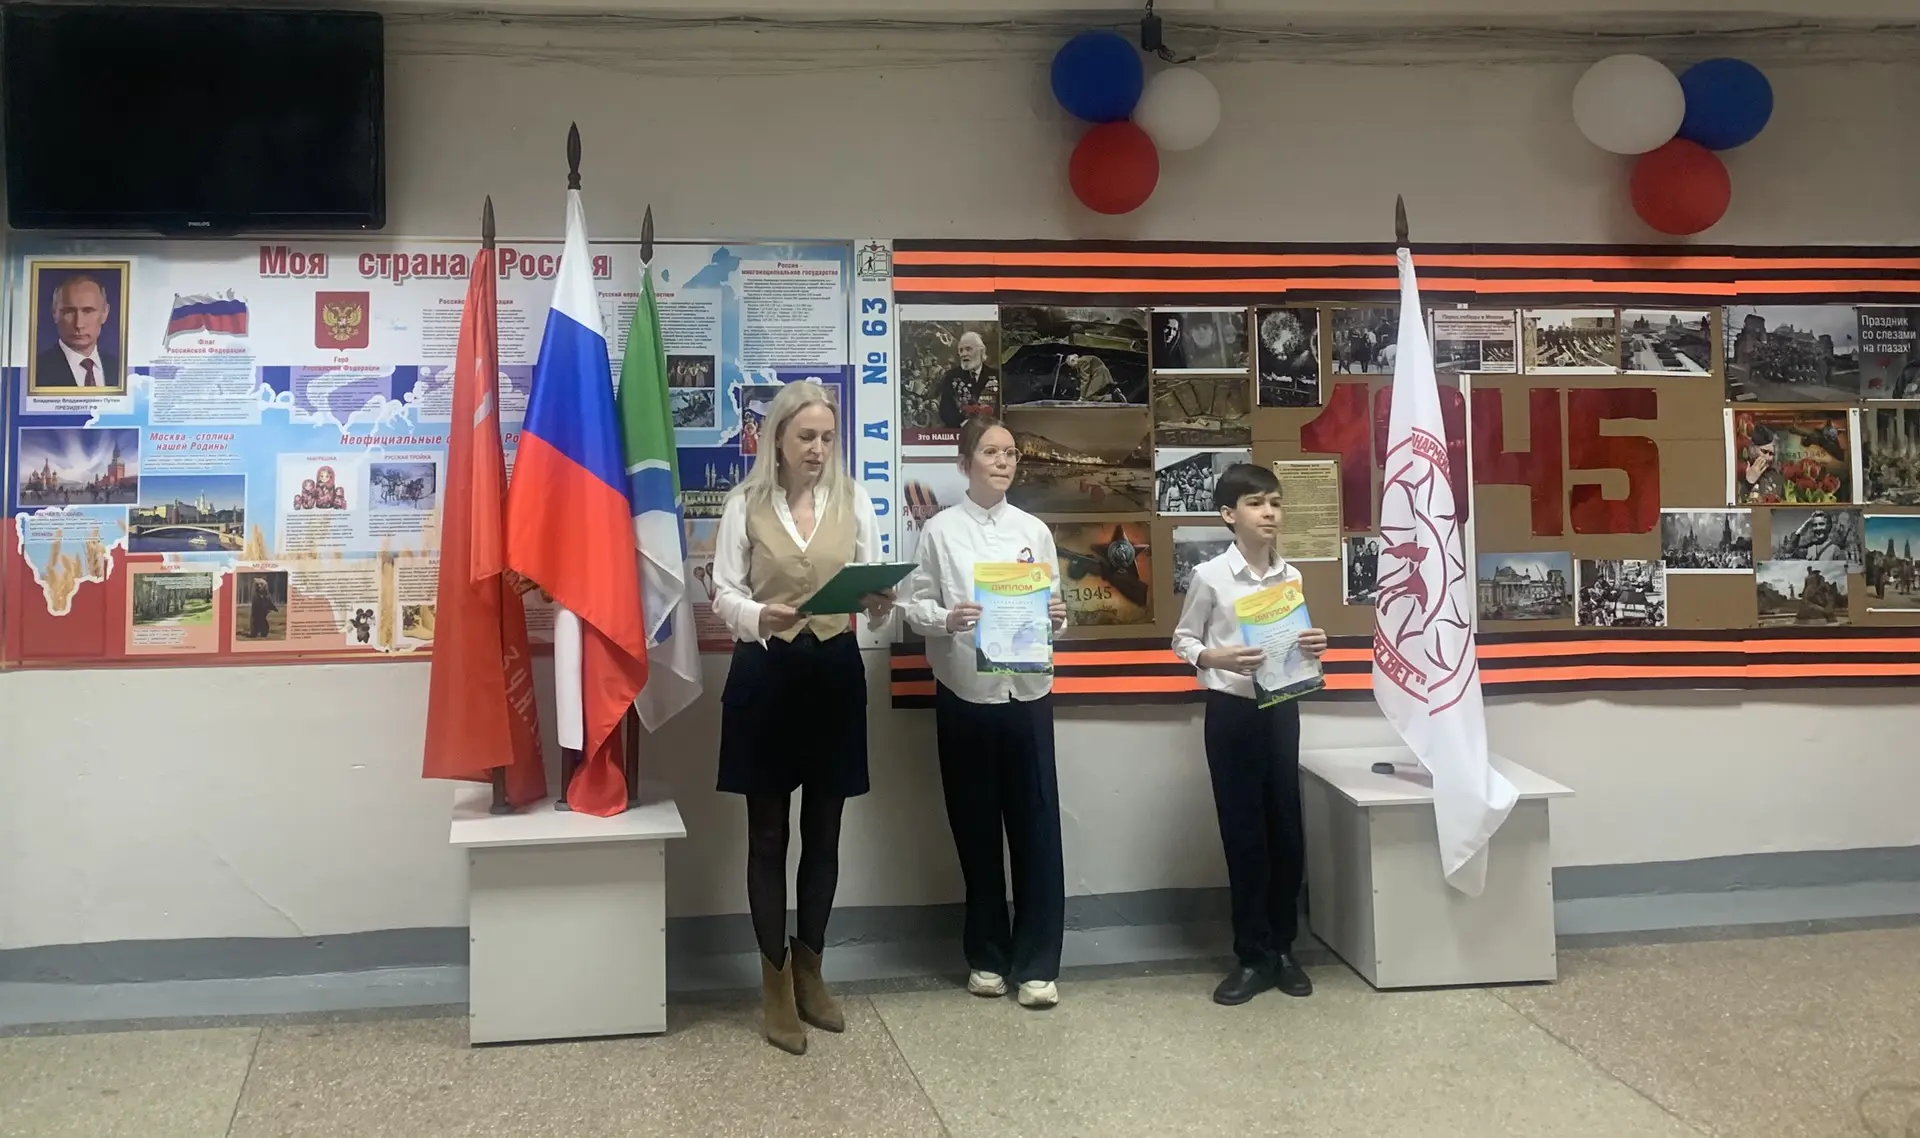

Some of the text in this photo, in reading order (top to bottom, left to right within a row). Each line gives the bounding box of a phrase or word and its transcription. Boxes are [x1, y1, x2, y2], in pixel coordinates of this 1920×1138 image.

[259, 245, 611, 285] Моя страна Рося
[861, 297, 888, 337] 63
[1861, 314, 1909, 328] Праздник
[1862, 330, 1917, 340] со слезами
[1863, 342, 1911, 353] на глазах!
[862, 352, 887, 385] №
[149, 432, 187, 441] Москва
[195, 432, 235, 441] столица
[340, 433, 442, 446] Неофициальные
[918, 433, 930, 441] Это
[931, 433, 955, 441] НАША
[156, 442, 228, 451] нашей Родины
[902, 505, 909, 516] Я
[907, 520, 913, 531] Я
[991, 584, 1033, 592] ДИПЛОМ
[1254, 605, 1291, 622] ДИПЛОМ
